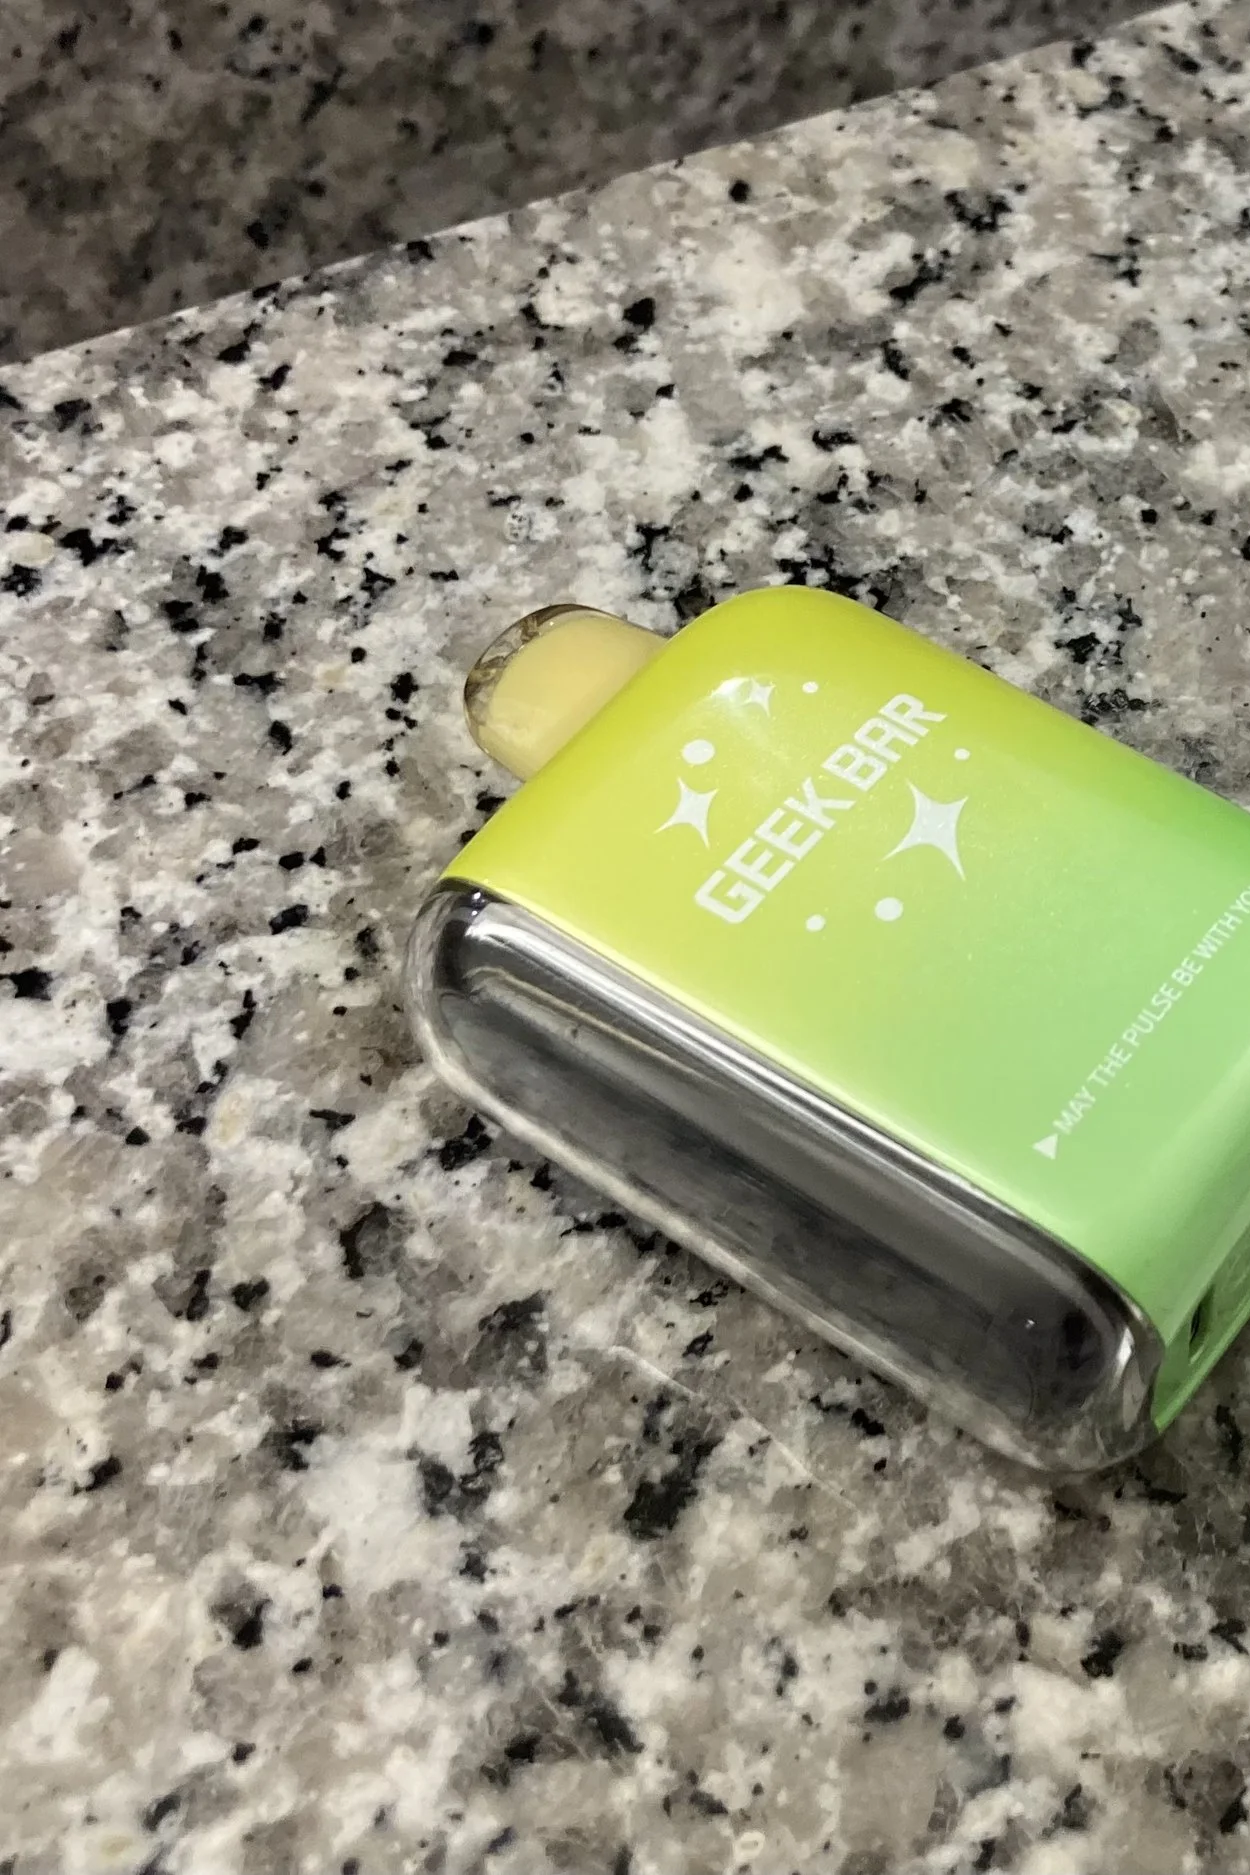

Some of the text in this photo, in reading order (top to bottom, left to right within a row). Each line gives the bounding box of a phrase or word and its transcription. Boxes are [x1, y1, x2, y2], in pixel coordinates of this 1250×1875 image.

[695, 693, 947, 924] GEEK BAR
[1053, 1086, 1096, 1135] MAY
[1087, 1043, 1132, 1087] THE
[1122, 983, 1183, 1047] PULSE
[1171, 957, 1203, 987] BE
[1193, 912, 1243, 959] WITH
